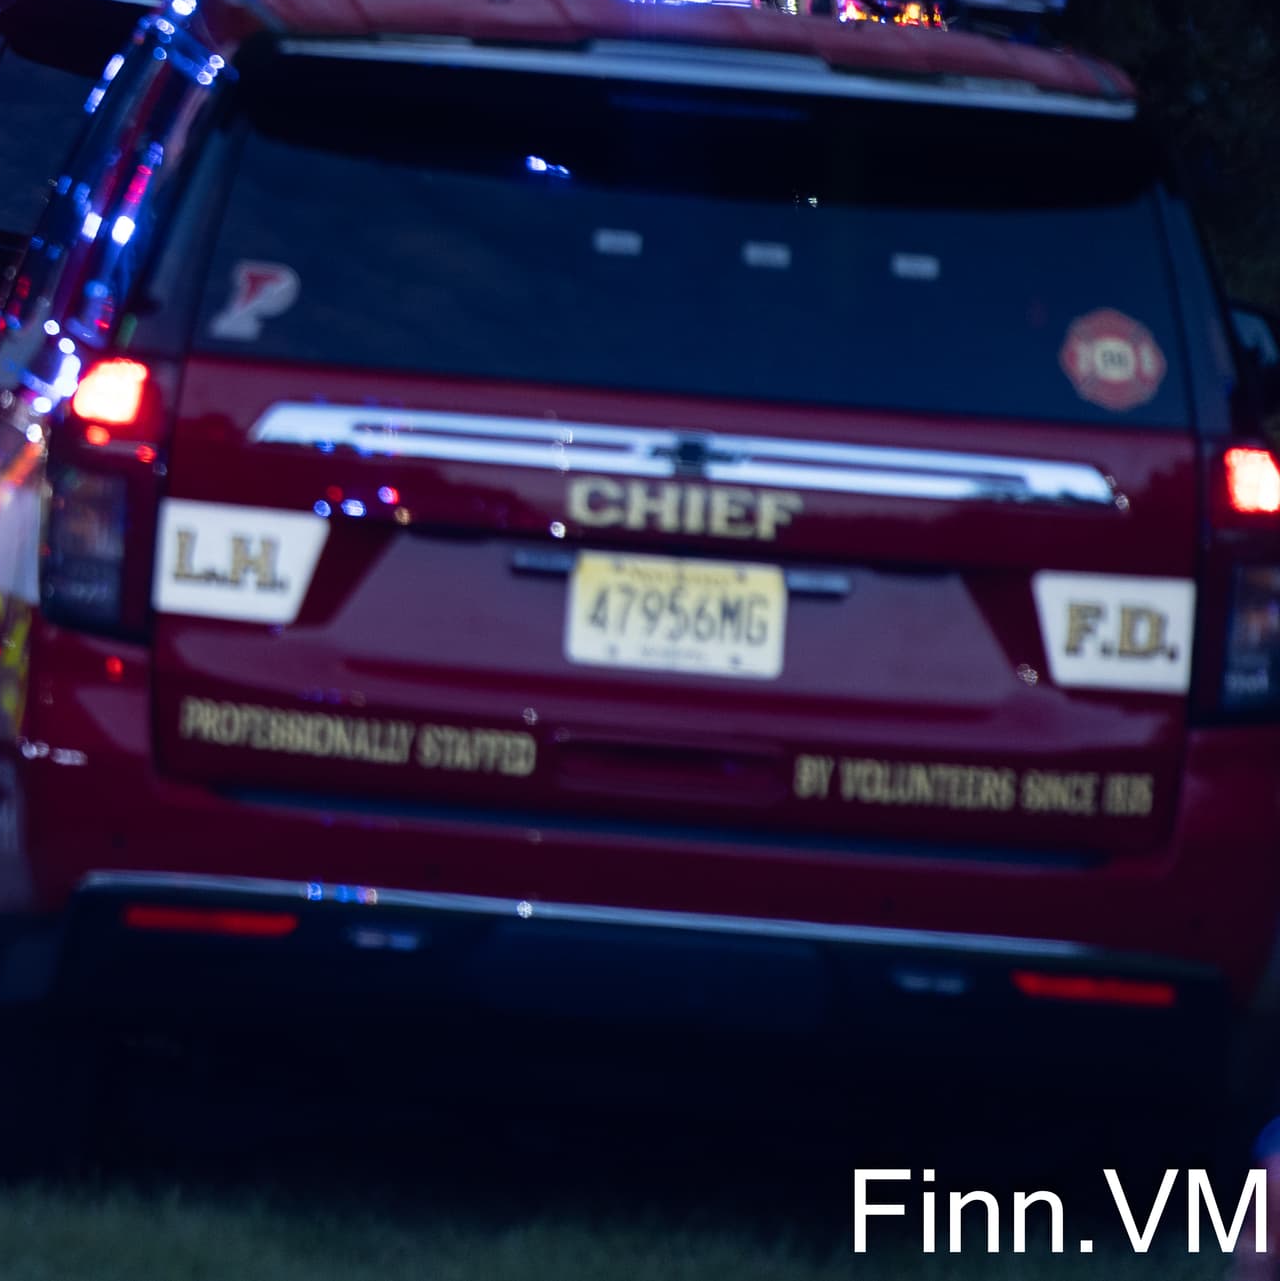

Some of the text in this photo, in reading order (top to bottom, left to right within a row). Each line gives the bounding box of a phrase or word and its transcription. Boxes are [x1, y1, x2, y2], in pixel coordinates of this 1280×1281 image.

[568, 475, 804, 540] CHIEF
[174, 528, 289, 594] L.H.
[588, 583, 770, 647] 47956MG
[1064, 601, 1178, 661] F.D.
[181, 696, 536, 776] PROFESSIONALLY STAFFED
[794, 754, 835, 799] BY
[840, 757, 1016, 811] VOLUNTEERS
